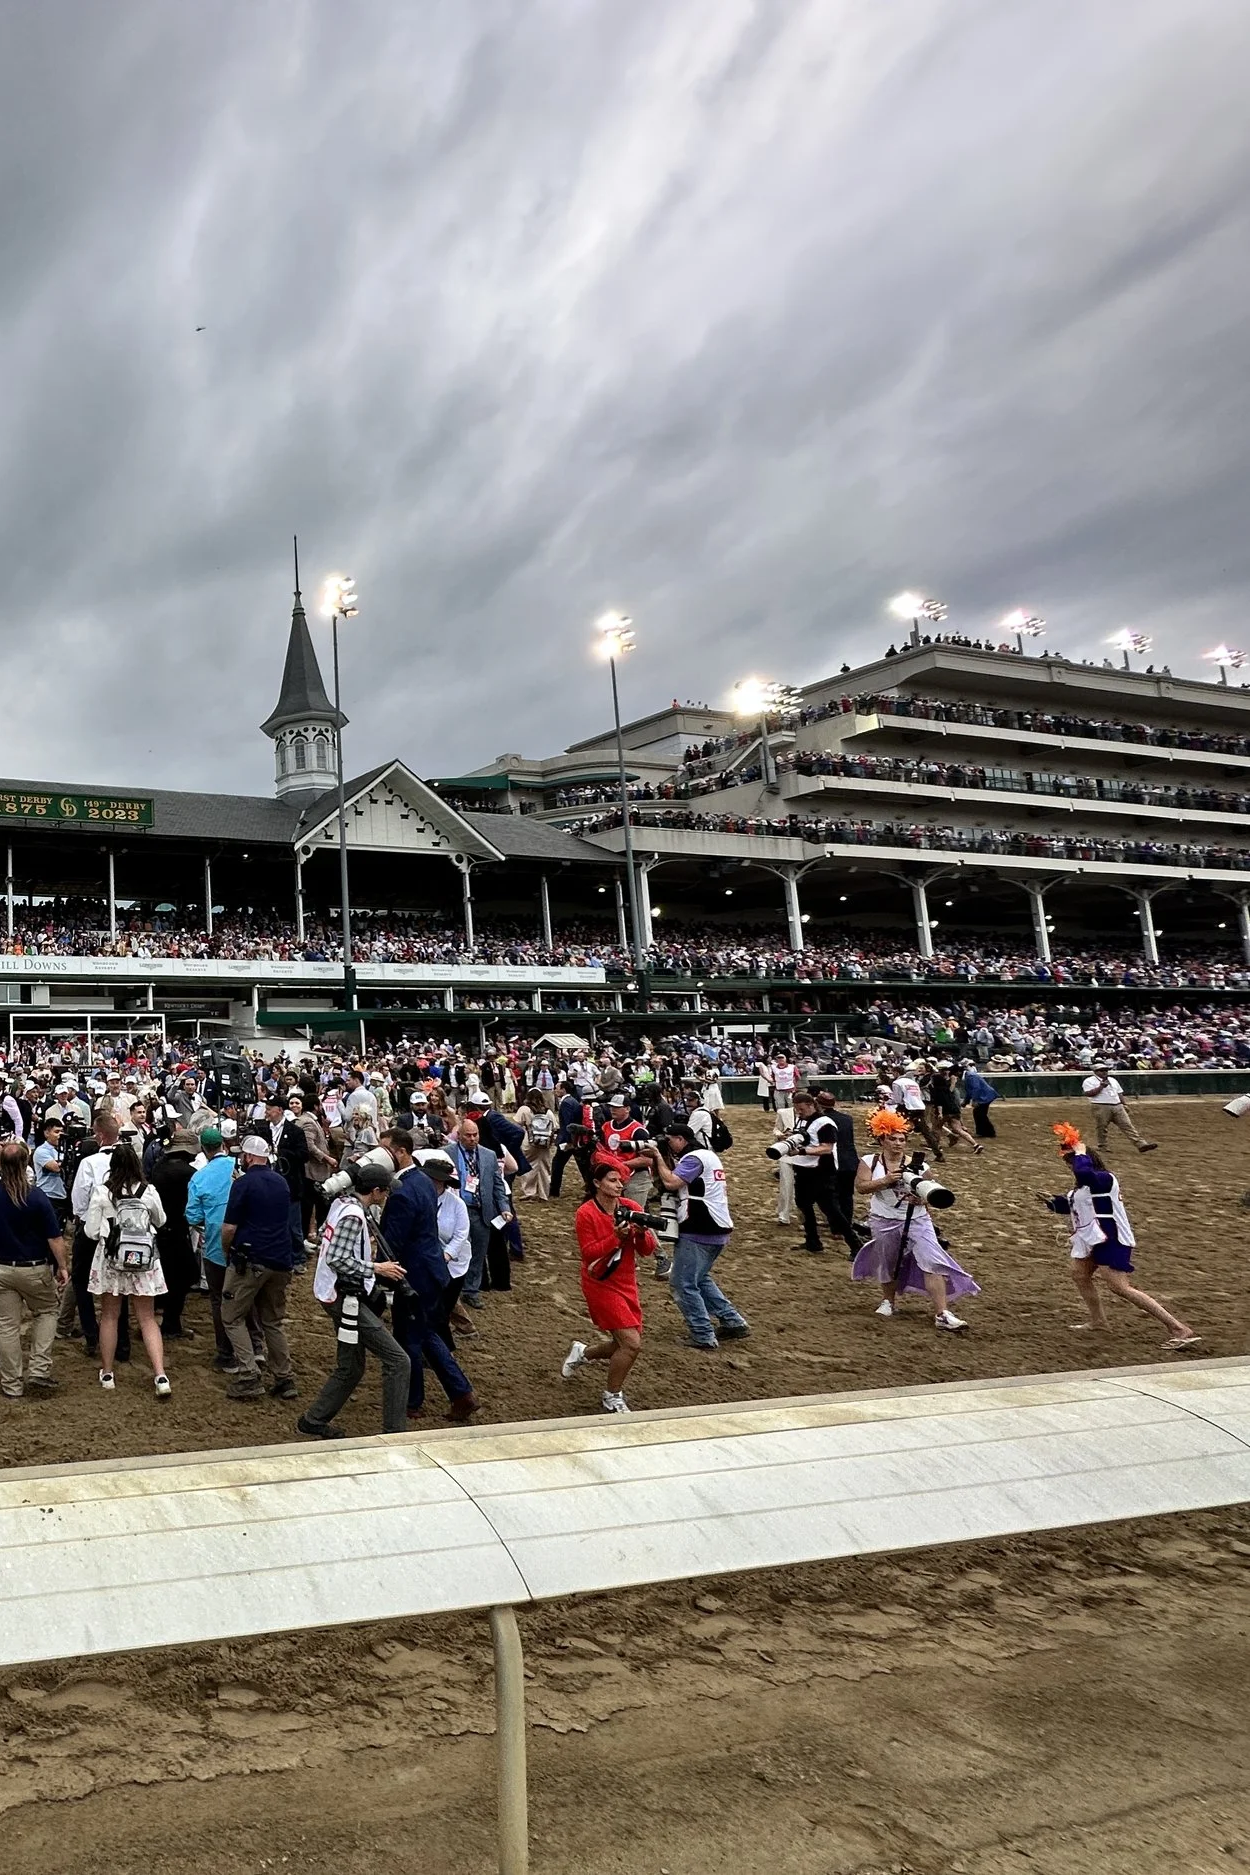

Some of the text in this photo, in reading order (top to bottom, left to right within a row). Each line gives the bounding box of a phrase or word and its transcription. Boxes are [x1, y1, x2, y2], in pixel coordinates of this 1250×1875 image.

[19, 795, 53, 805] DERBY
[110, 802, 146, 810] DERBY
[88, 808, 139, 821] 2023
[24, 959, 67, 971] DOWNS
